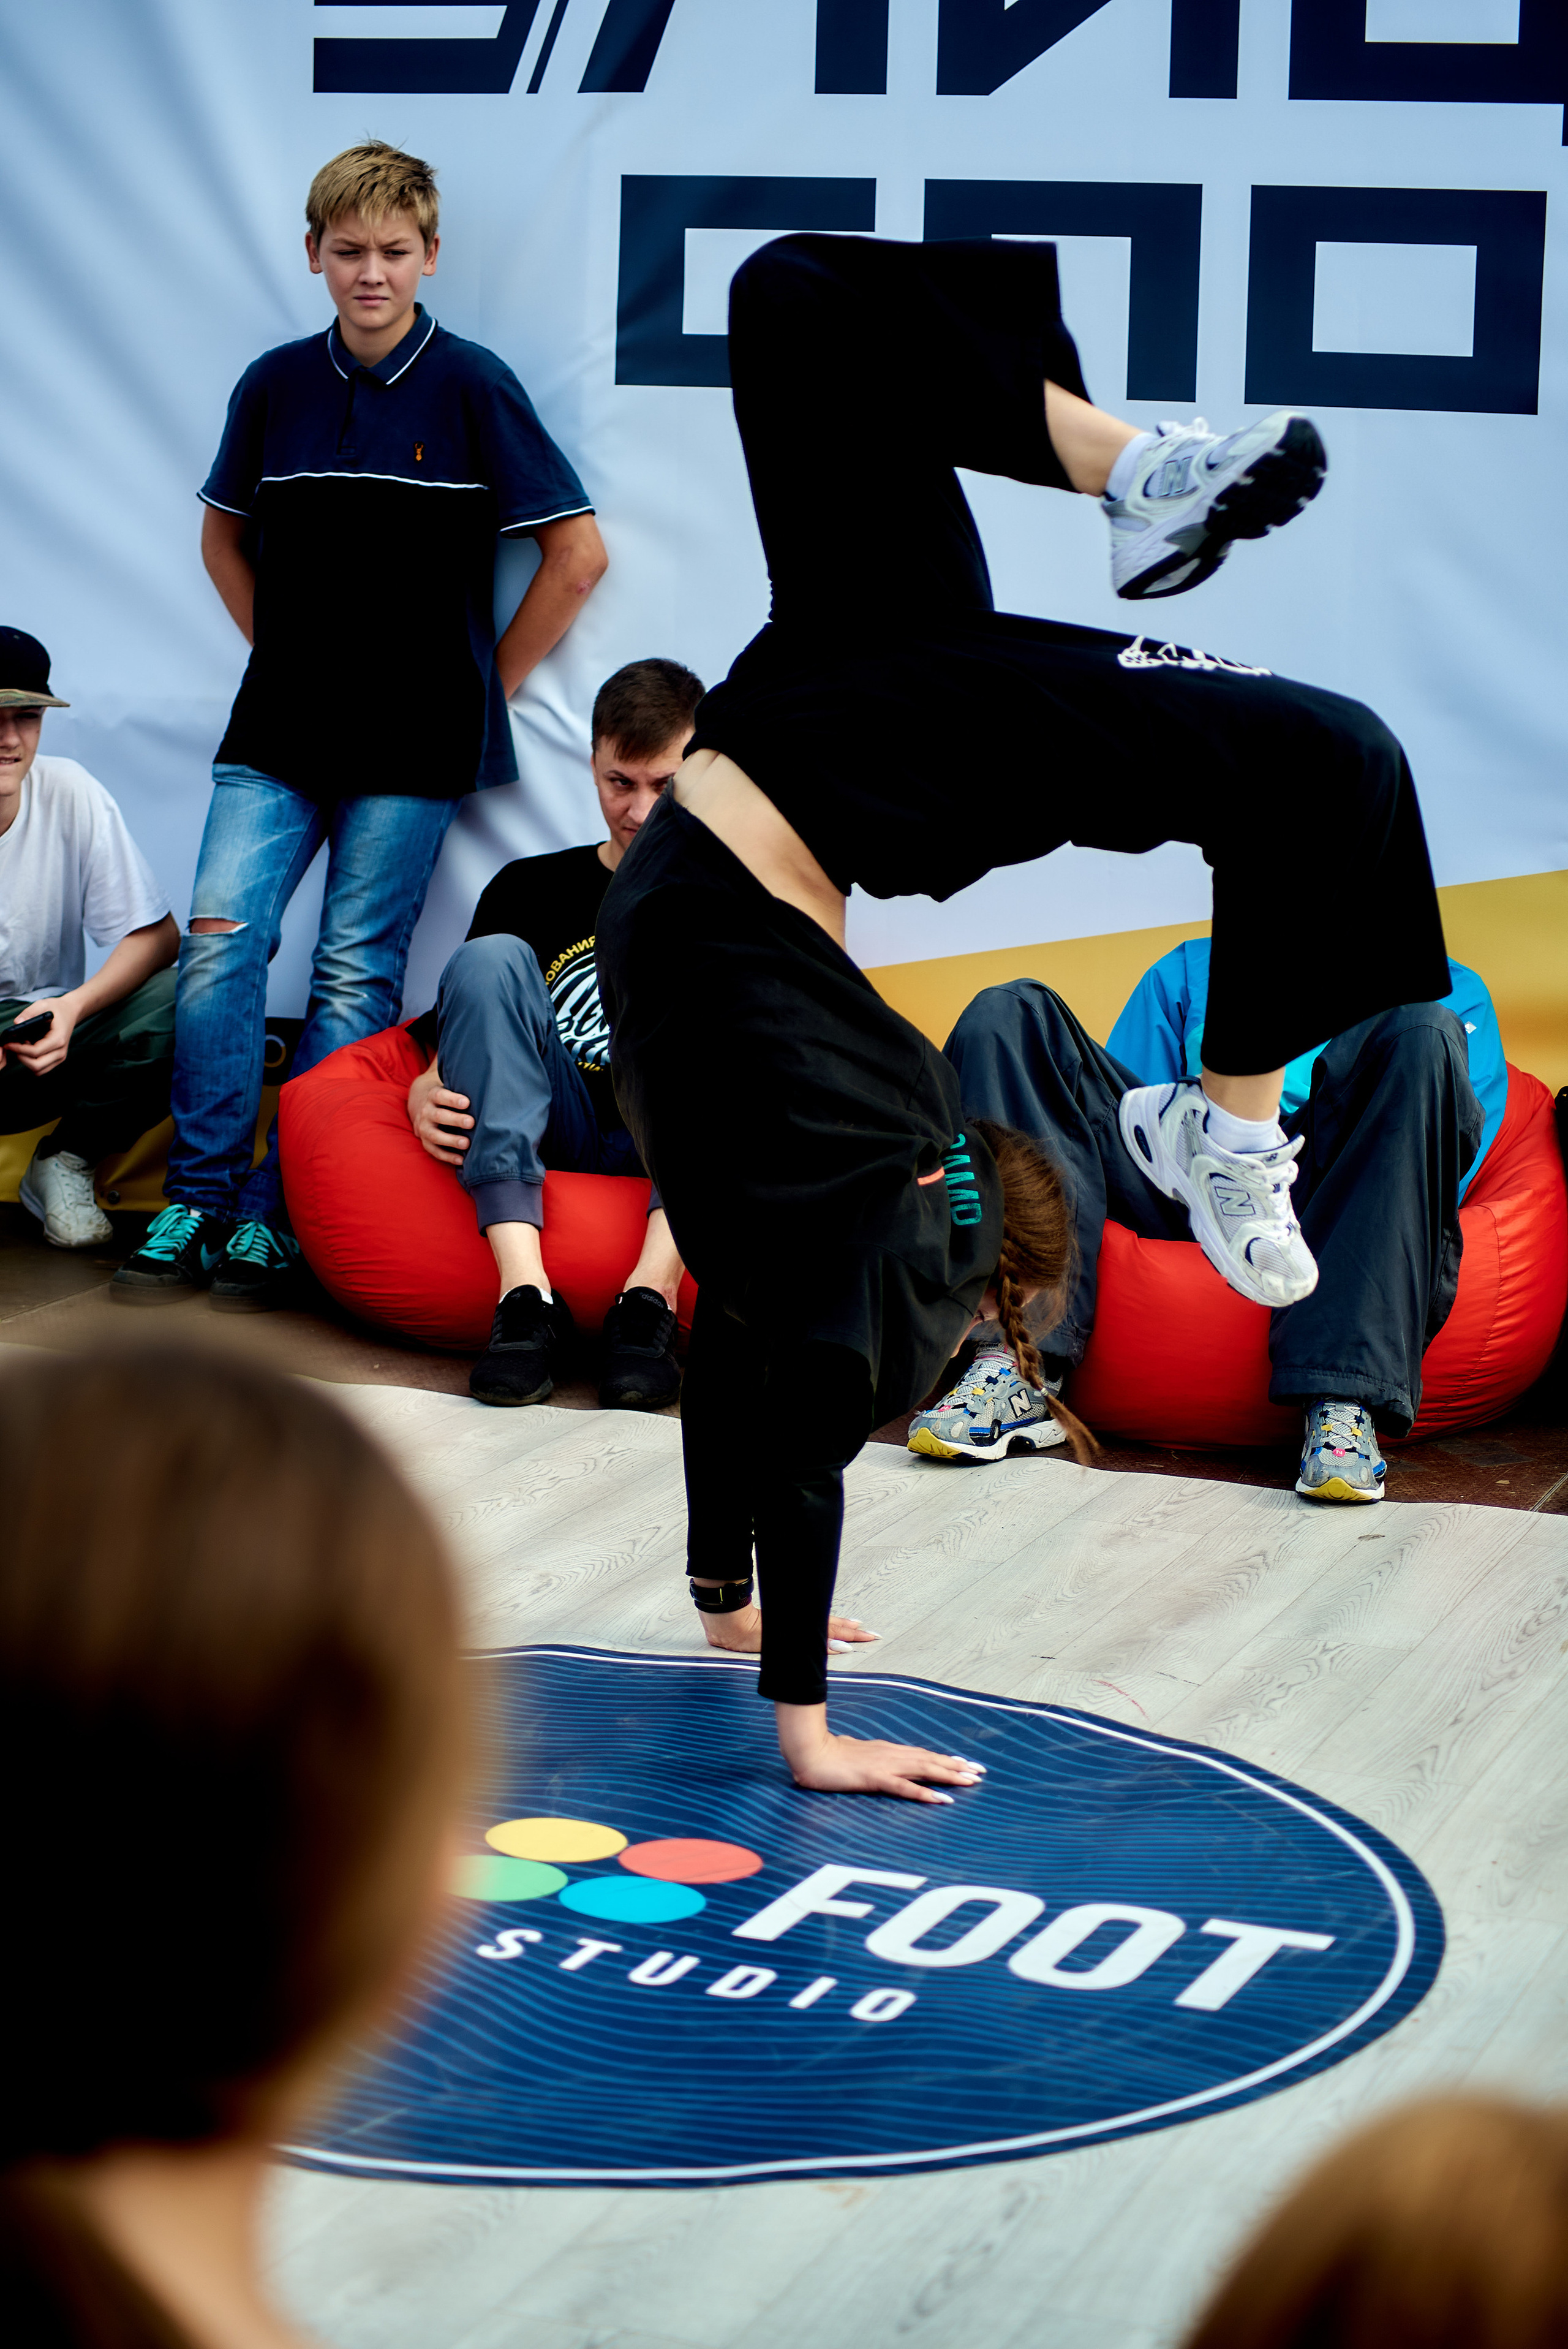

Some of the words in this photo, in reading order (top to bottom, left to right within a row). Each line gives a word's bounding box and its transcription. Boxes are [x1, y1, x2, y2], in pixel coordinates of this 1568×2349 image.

[545, 935, 595, 985] ОВАНИЯ
[1215, 1186, 1256, 1216] N
[1008, 1388, 1033, 1418] N
[731, 1864, 1336, 2011] FOOT
[476, 1929, 917, 2022] STUDIO
